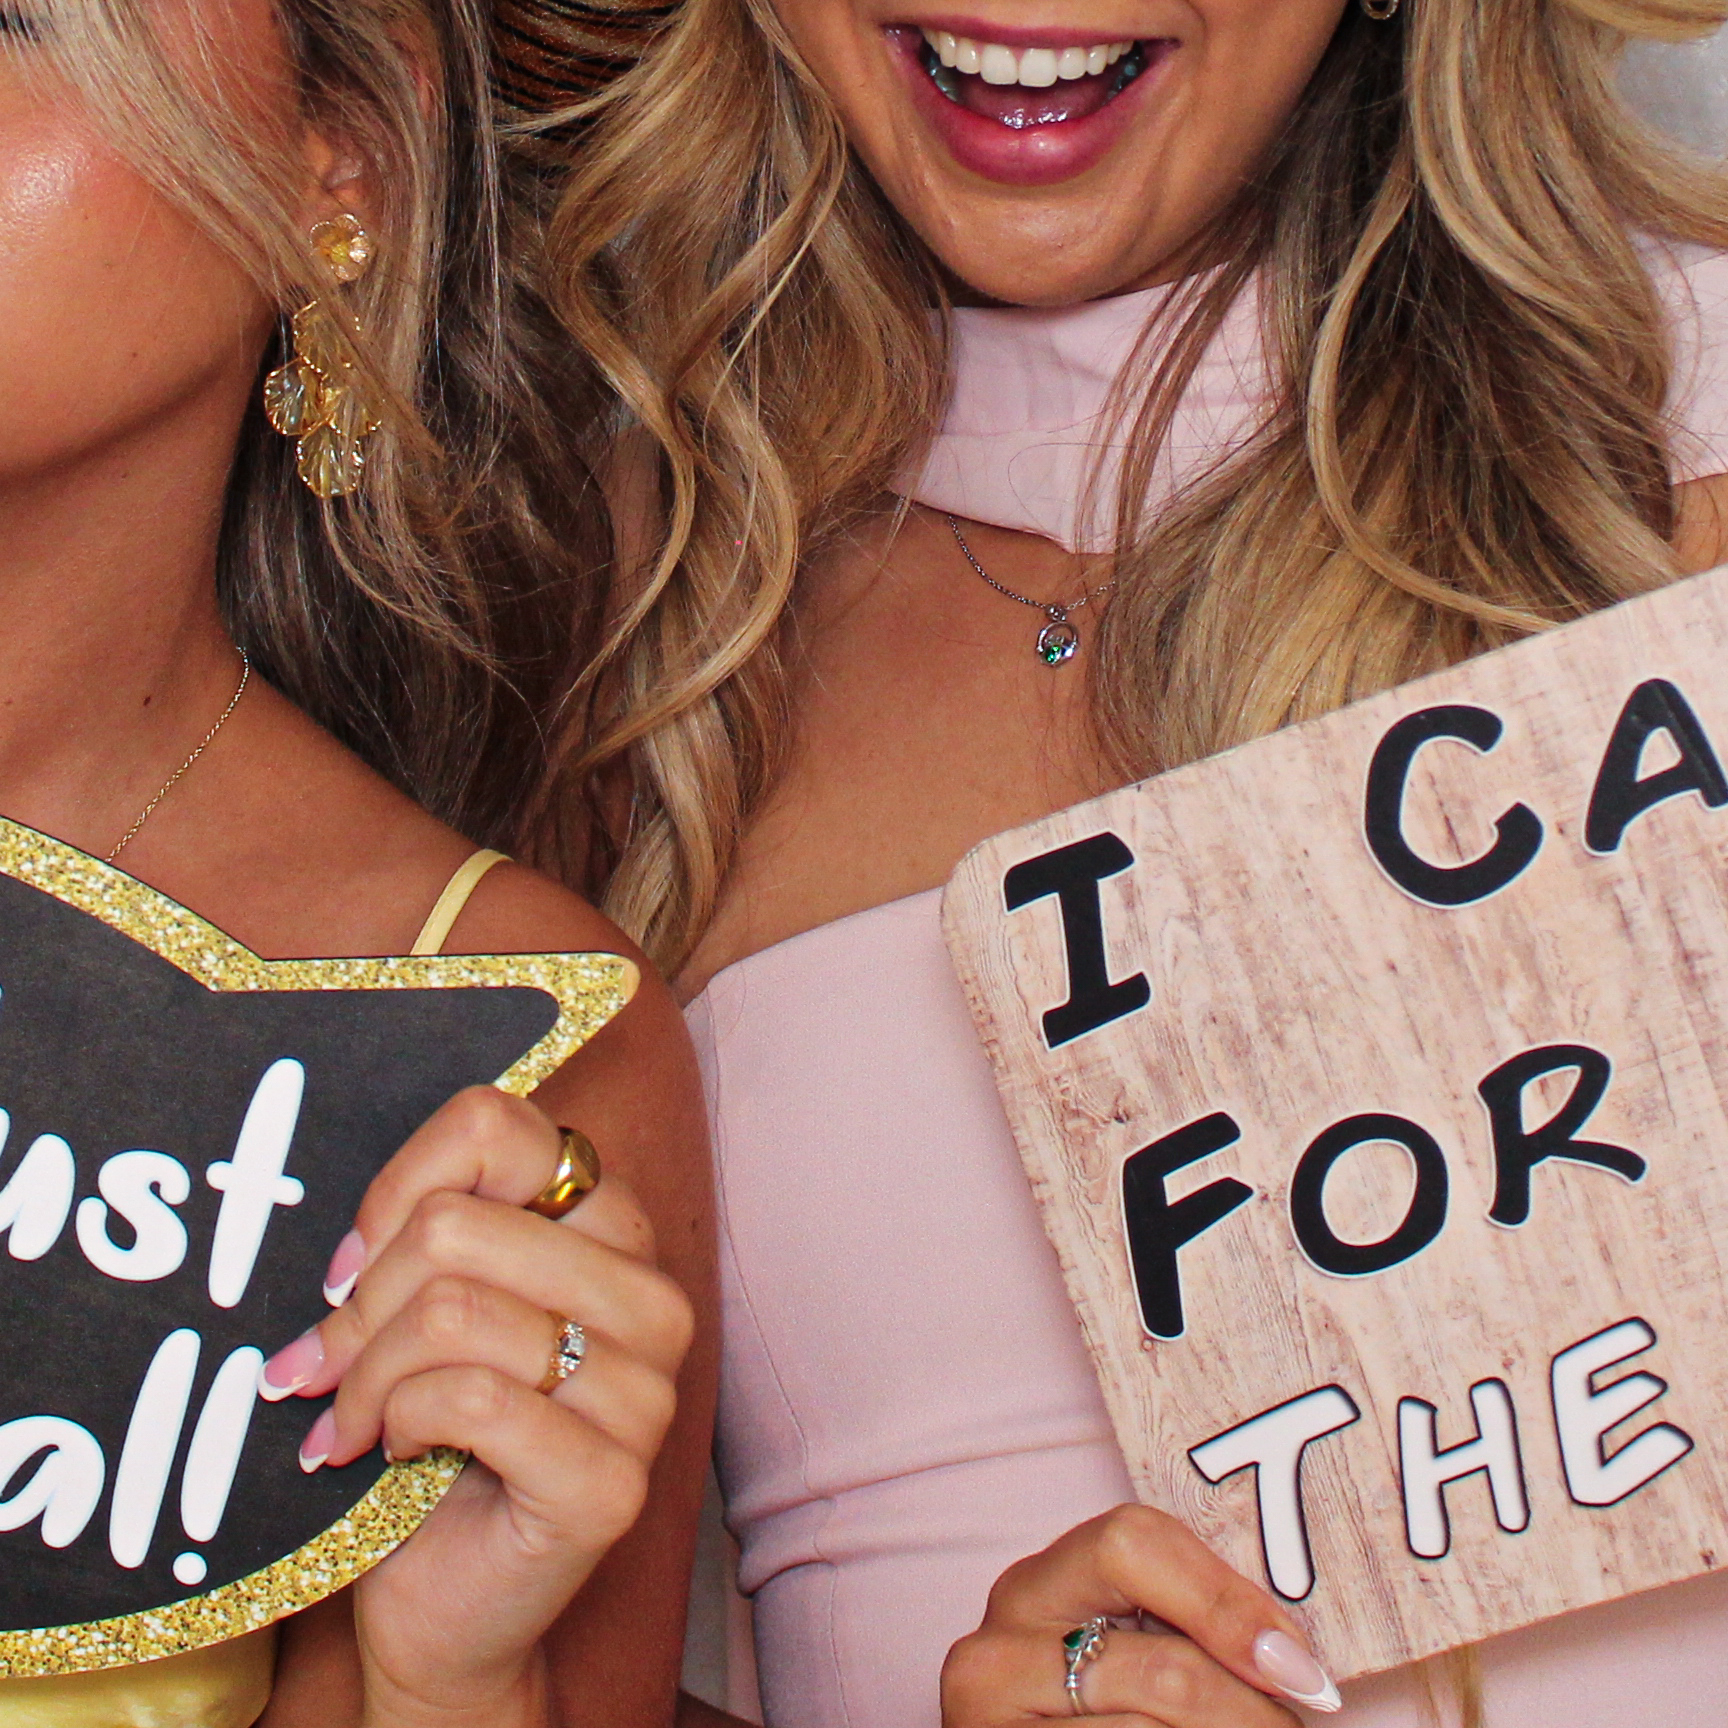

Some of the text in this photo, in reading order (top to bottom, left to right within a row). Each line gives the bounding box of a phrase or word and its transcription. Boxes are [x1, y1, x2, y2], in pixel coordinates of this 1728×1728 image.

[1002, 830, 1152, 1049] I
[1120, 1043, 1645, 1343] FOR
[1188, 1315, 1694, 1601] THE
